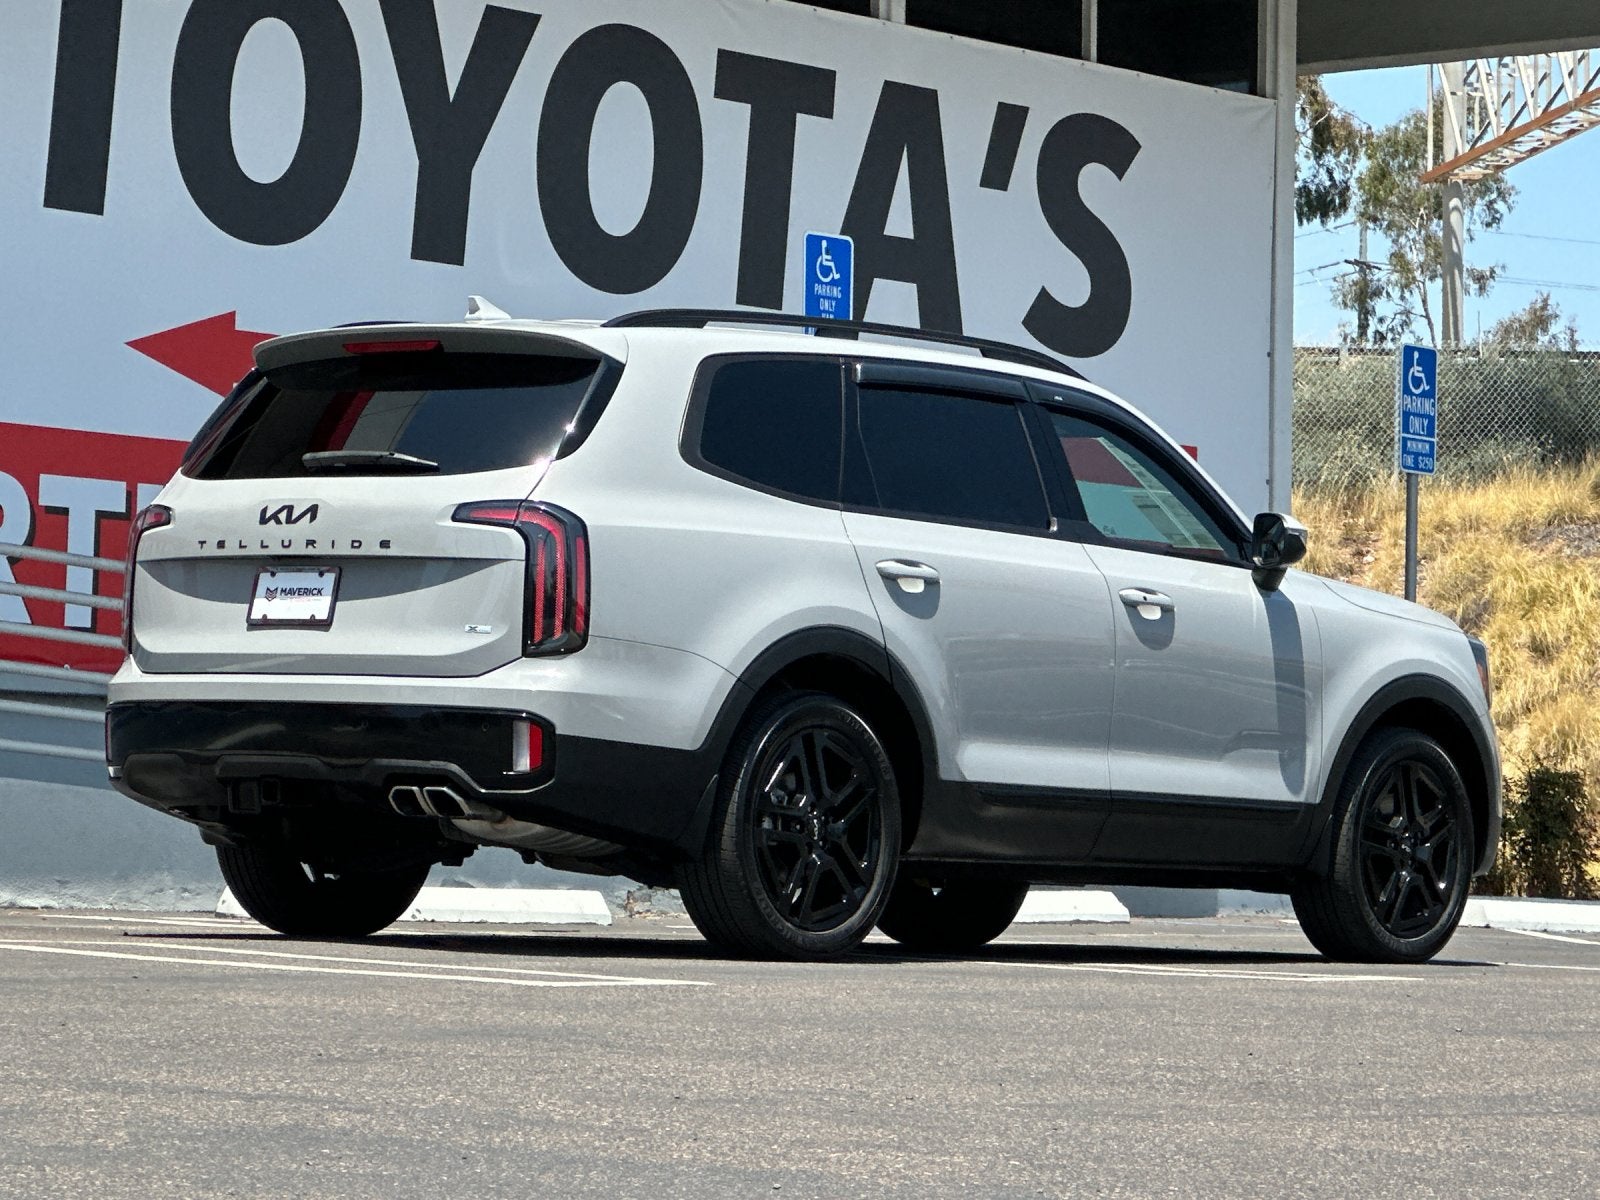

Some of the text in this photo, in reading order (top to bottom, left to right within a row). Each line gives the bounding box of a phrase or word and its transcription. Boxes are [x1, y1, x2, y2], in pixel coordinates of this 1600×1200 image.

[814, 283, 842, 299] PARKING
[819, 298, 836, 312] ONLY
[1403, 394, 1435, 416] PARKING
[1409, 415, 1428, 435] ONLY
[1403, 453, 1415, 467] FINE
[1418, 455, 1433, 470] $250
[259, 503, 319, 525] KIA
[198, 539, 391, 549] TELLURIDE
[280, 587, 324, 596] MAVERICK
